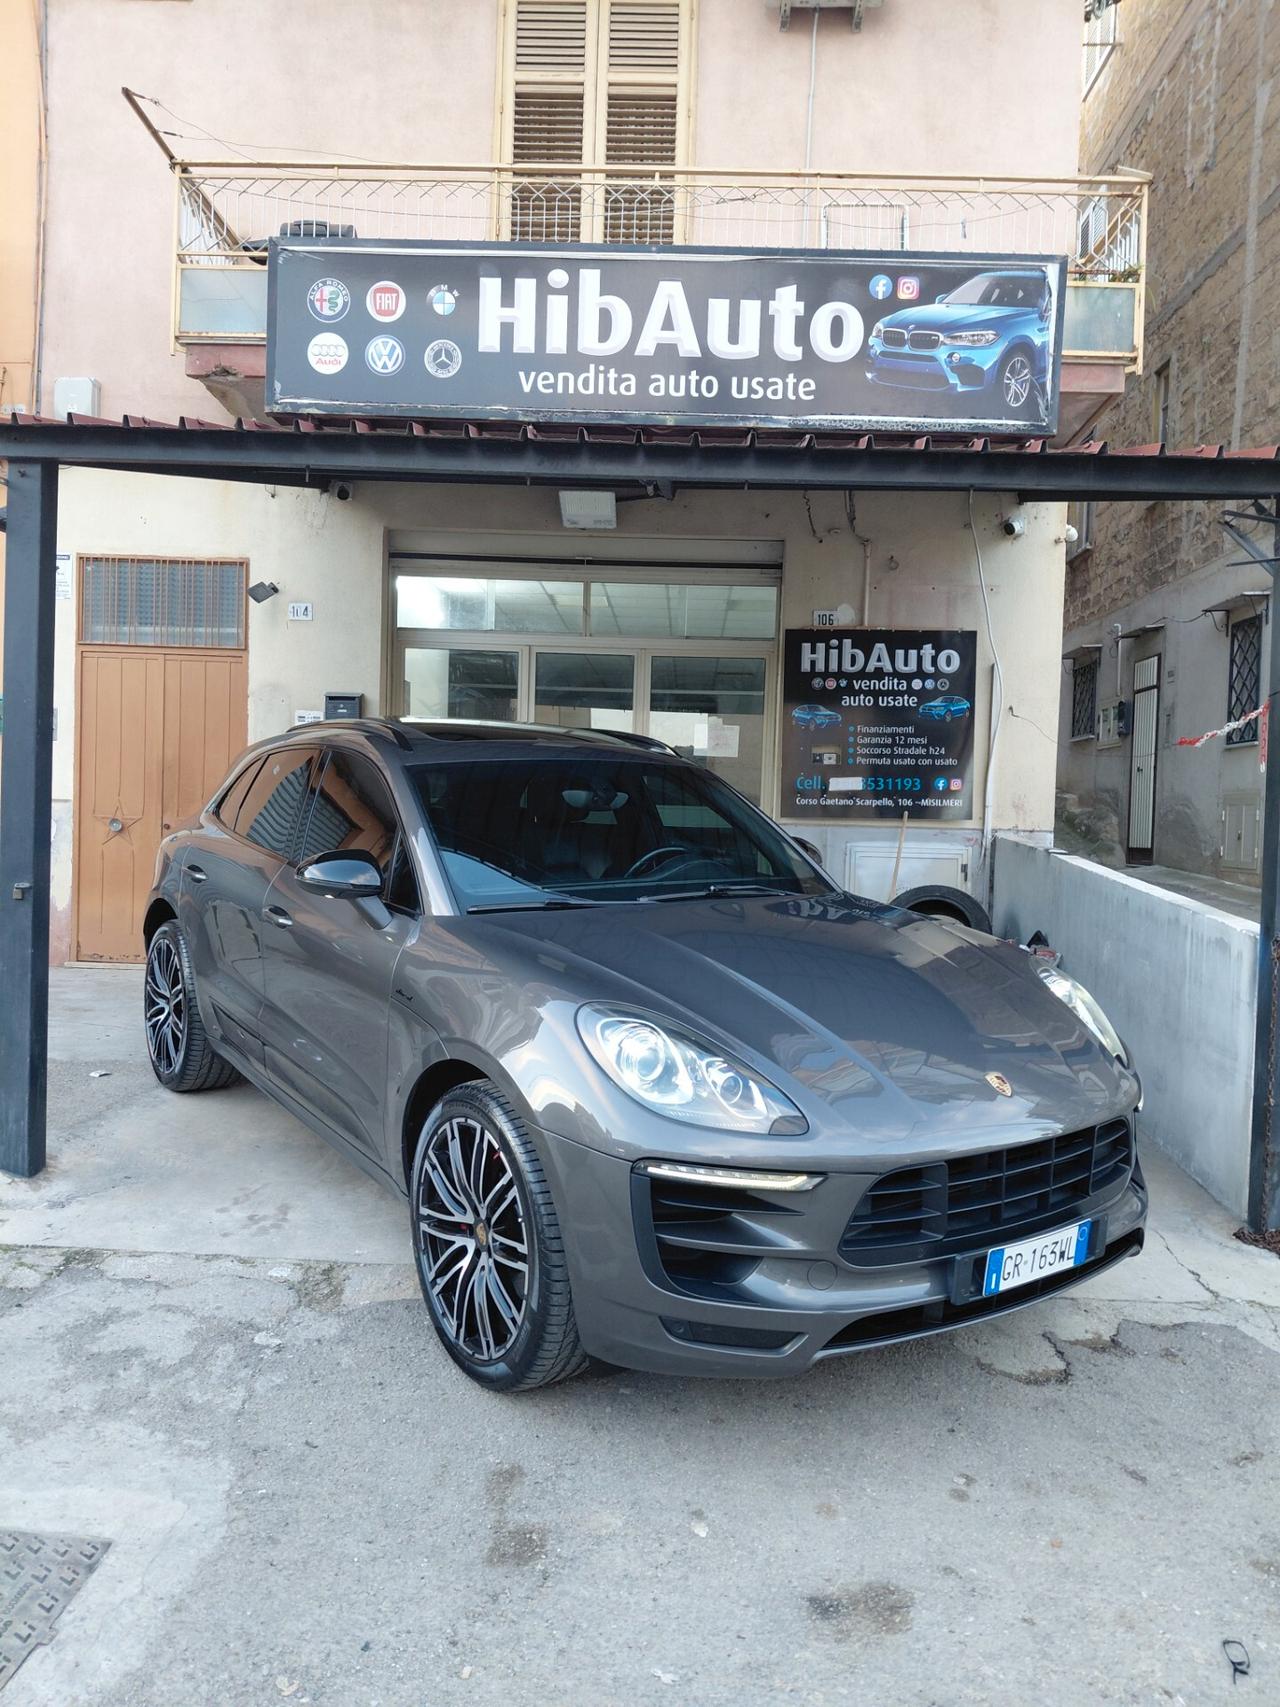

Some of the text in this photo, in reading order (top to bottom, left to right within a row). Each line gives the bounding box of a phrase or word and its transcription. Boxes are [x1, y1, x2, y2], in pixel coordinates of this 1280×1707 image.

[309, 280, 348, 302] ALFA ROMEO
[376, 293, 397, 310] FIAT
[478, 268, 864, 363] HibAuto
[519, 363, 817, 401] vendita auto usate
[818, 614, 834, 625] 106
[801, 638, 961, 673] HibAuto
[853, 677, 907, 690] vendita
[842, 695, 918, 706] auto usate
[857, 725, 914, 733] Finanziamenti
[857, 736, 891, 744] Garanzia
[894, 747, 926, 755] Stradale
[930, 747, 945, 755] h24
[796, 776, 825, 789] Cell.
[796, 797, 817, 805] Corso
[820, 797, 853, 805] Gaetano
[856, 798, 895, 807] Scarpello,
[1002, 1253, 1023, 1281] GR
[1031, 1236, 1074, 1272] 163WL
